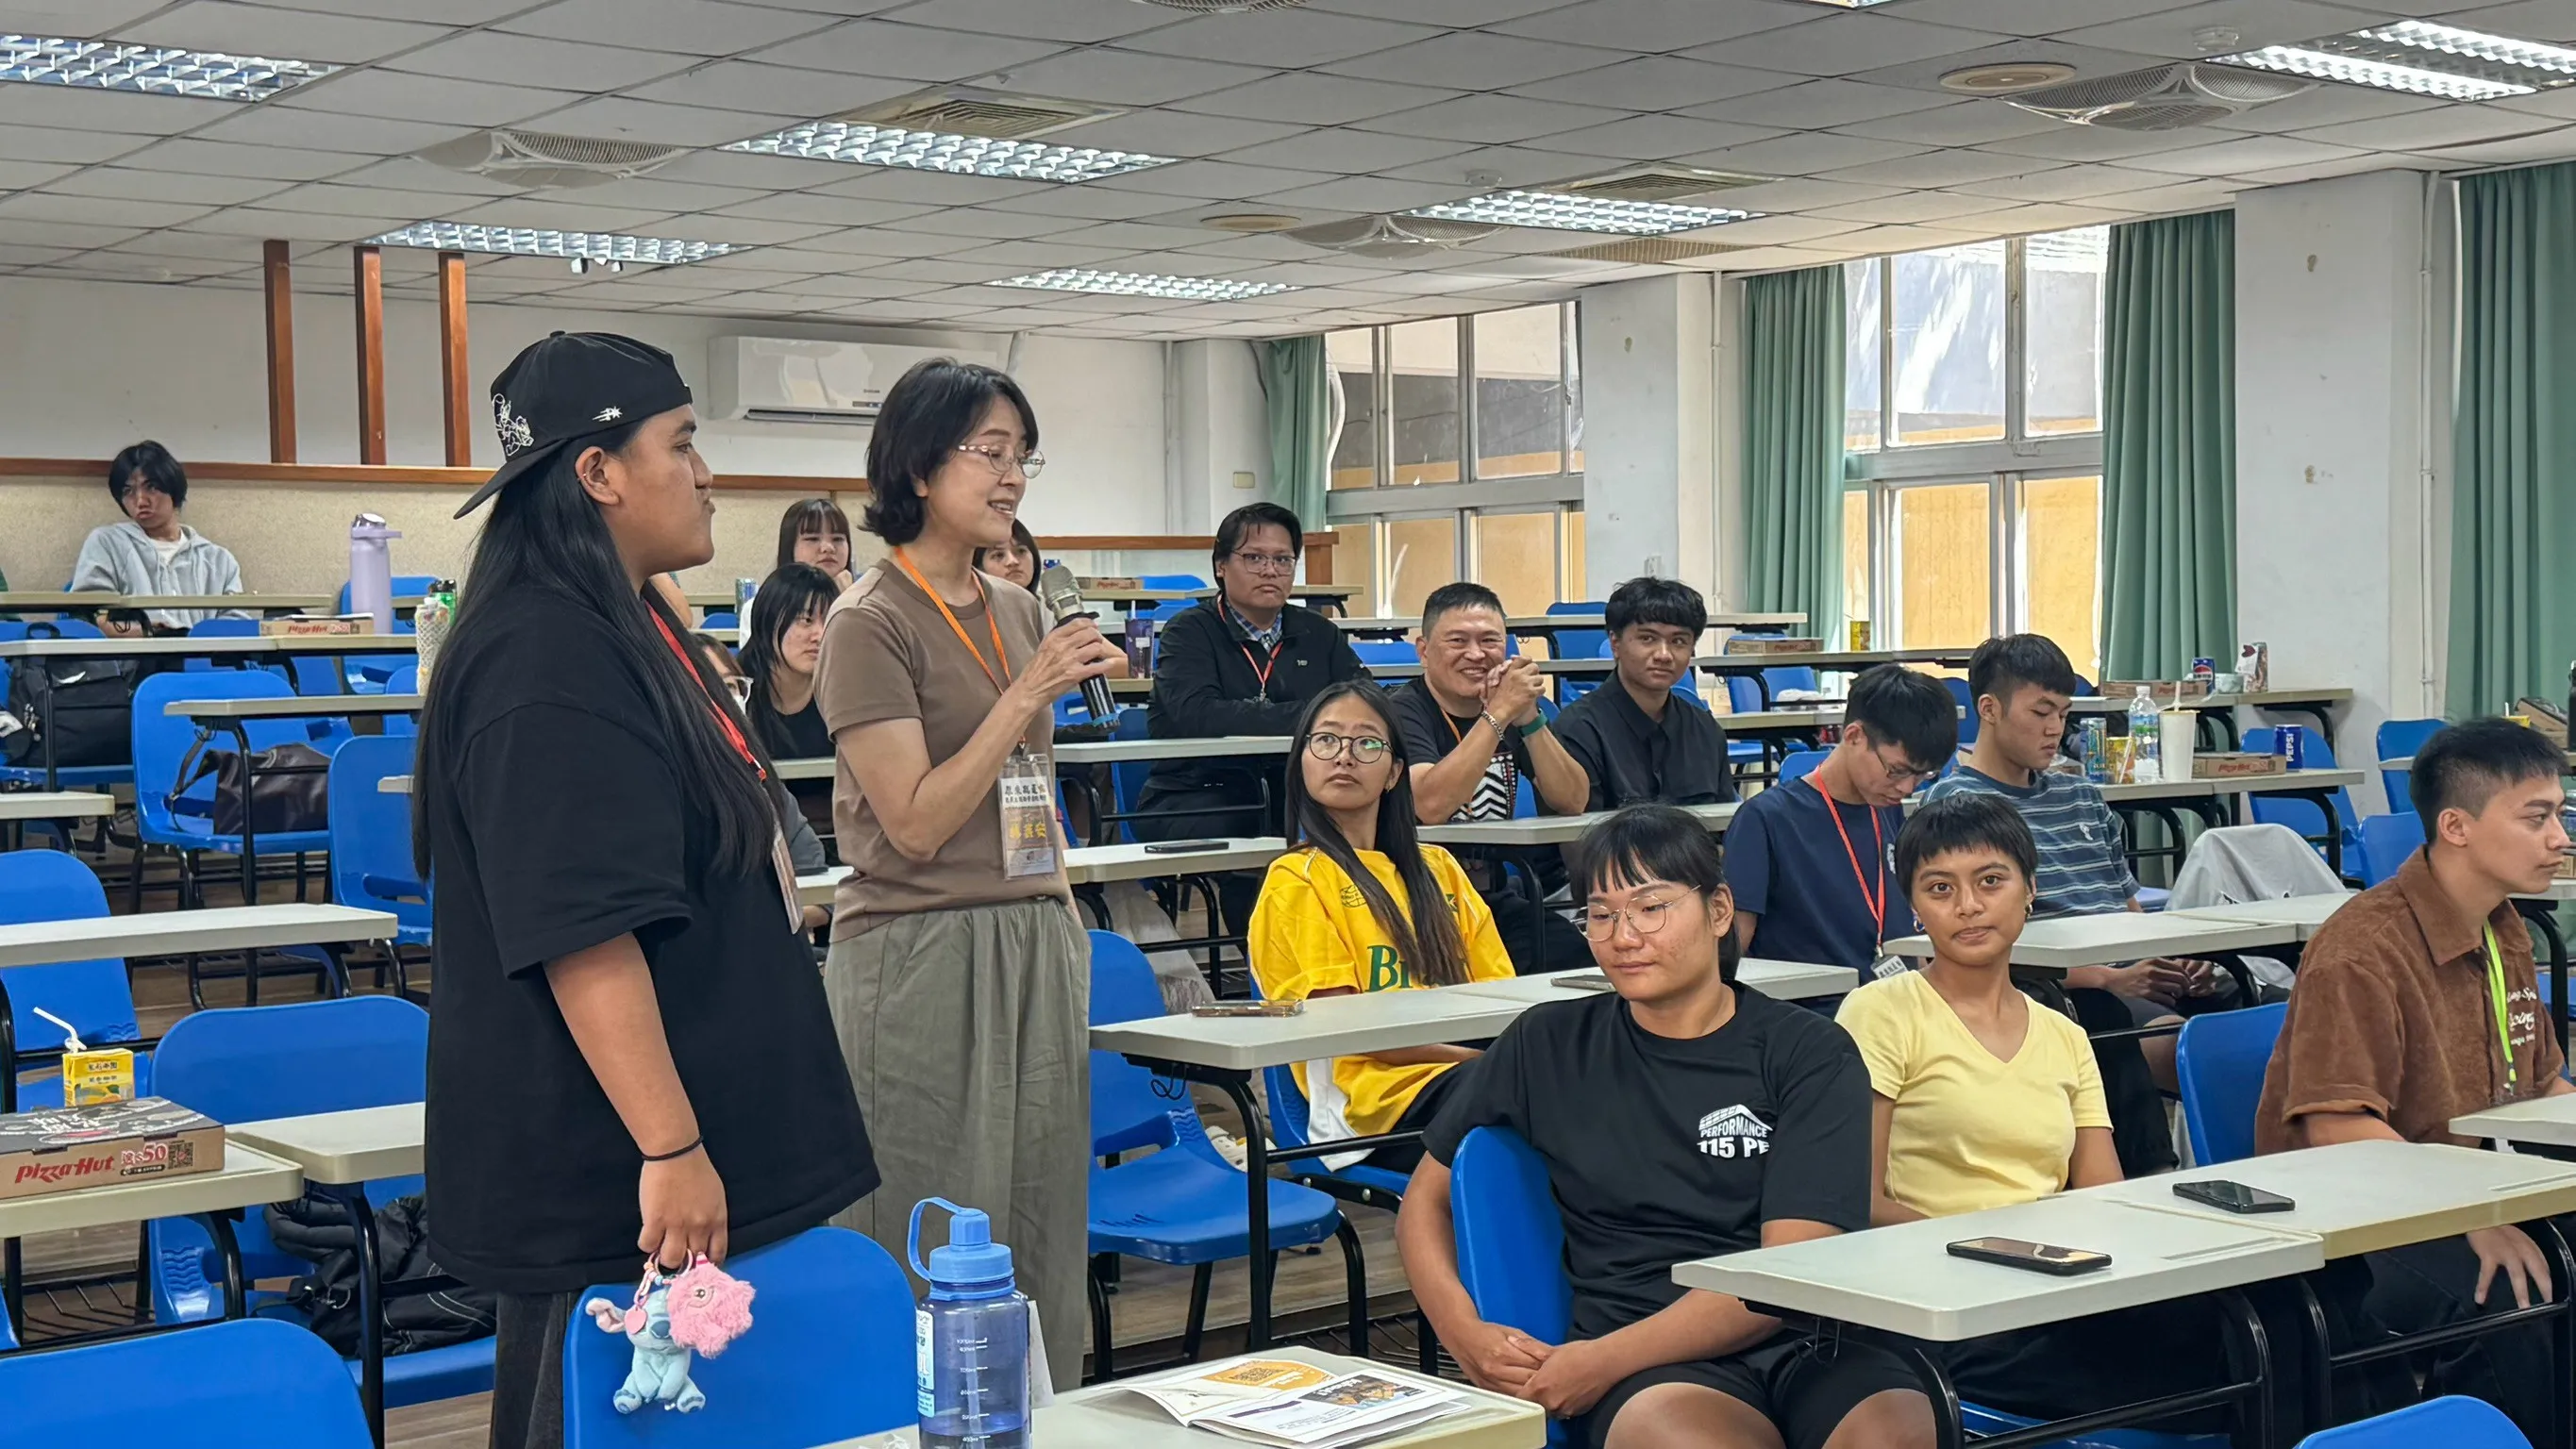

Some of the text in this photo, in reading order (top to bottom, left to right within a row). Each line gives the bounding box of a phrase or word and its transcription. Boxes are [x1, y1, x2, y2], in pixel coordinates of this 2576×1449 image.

[1700, 1115, 1767, 1138] PERFORMANCE
[1697, 1137, 1735, 1158] 115
[15, 1161, 72, 1183] Pizza
[75, 1156, 114, 1176] Hut
